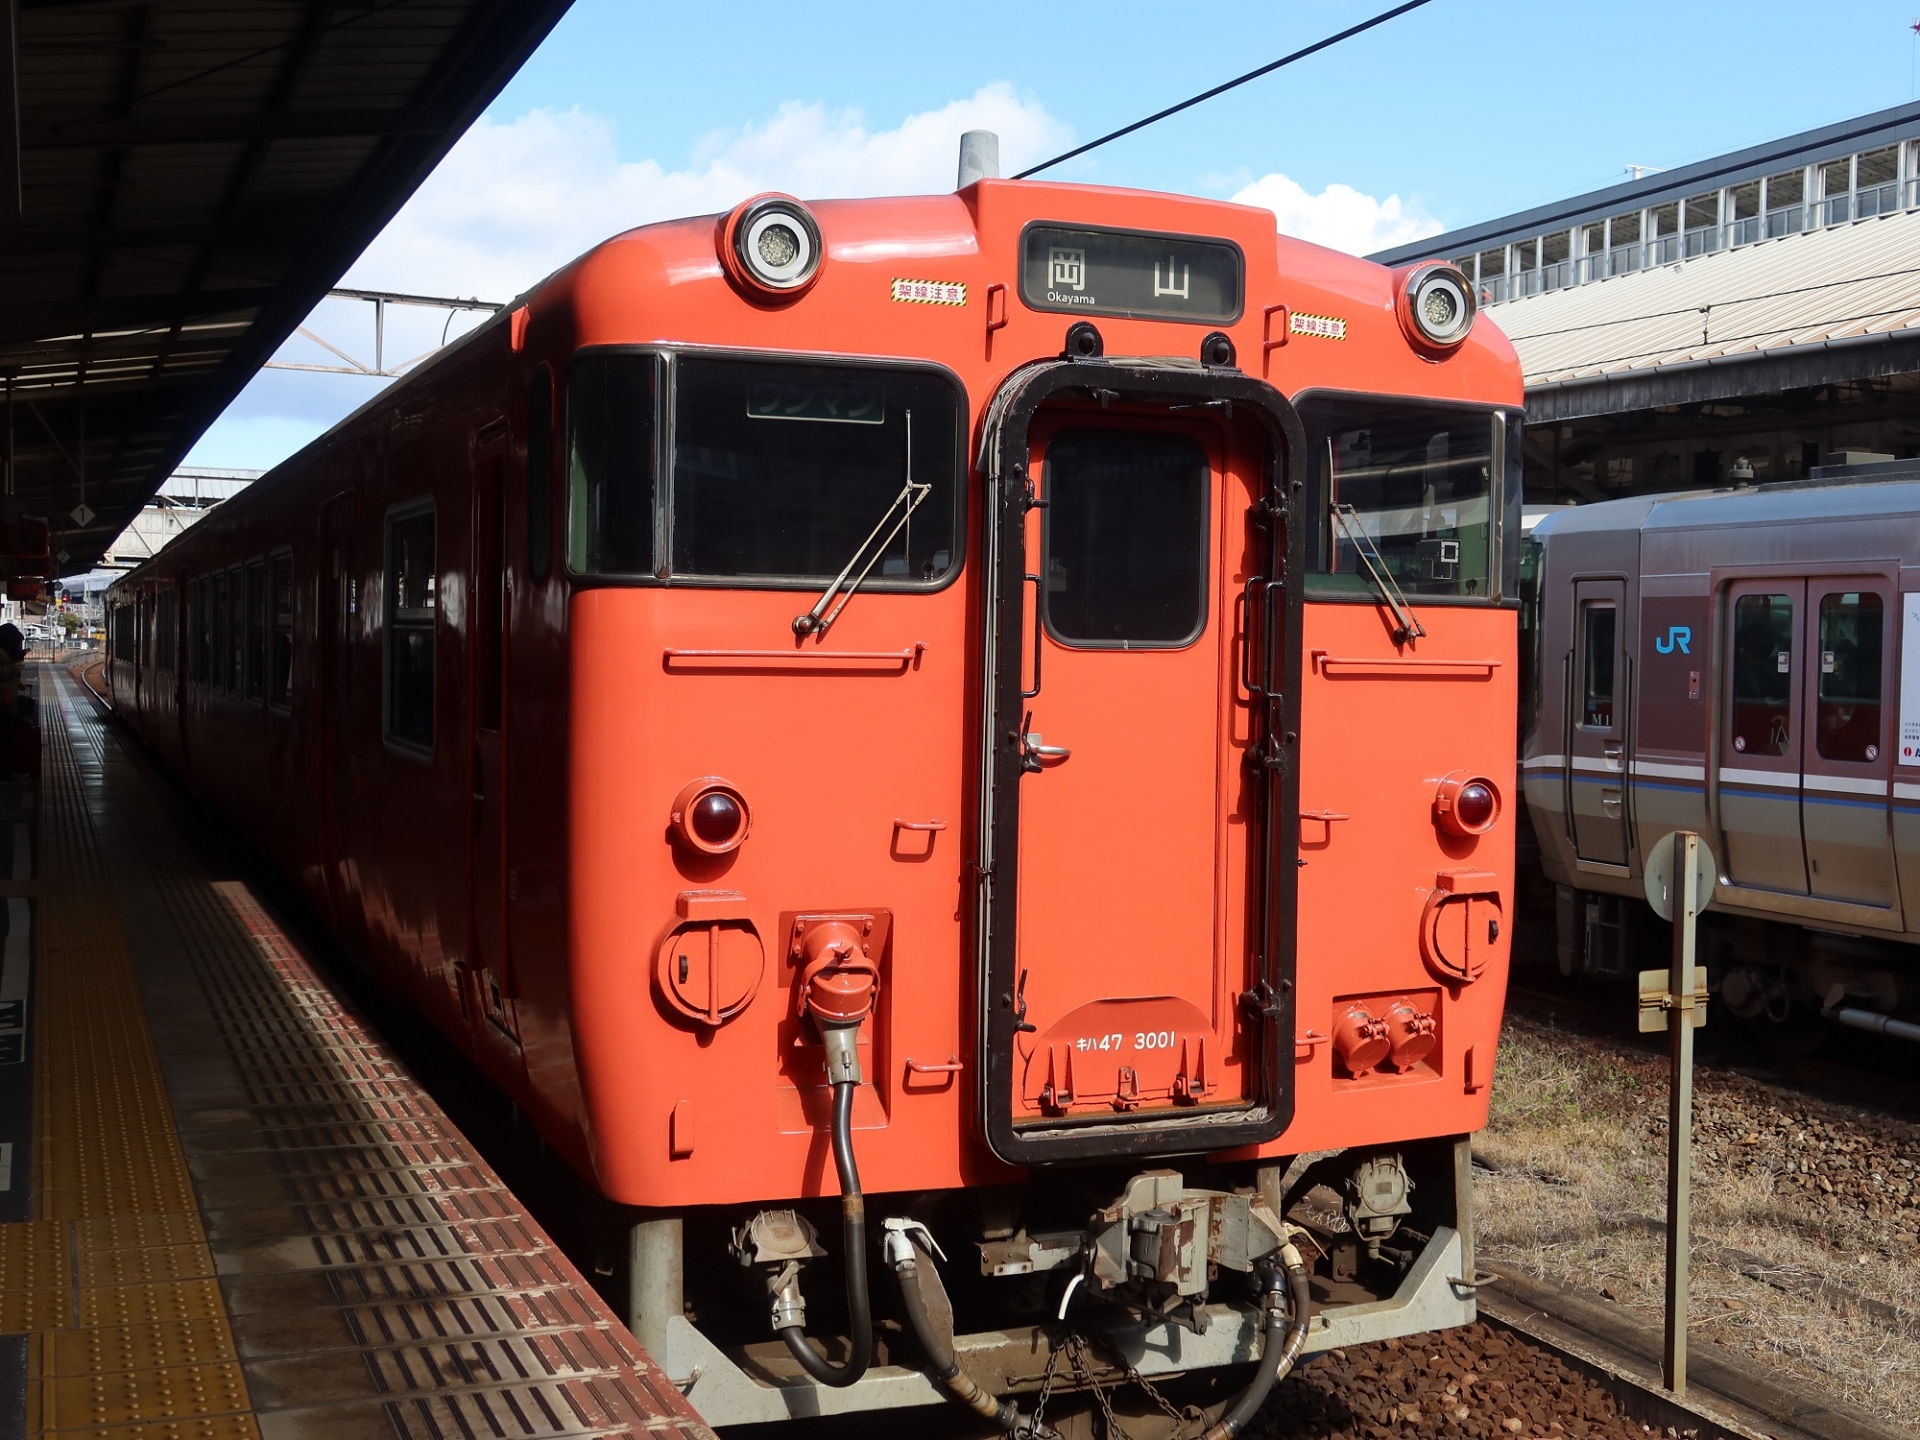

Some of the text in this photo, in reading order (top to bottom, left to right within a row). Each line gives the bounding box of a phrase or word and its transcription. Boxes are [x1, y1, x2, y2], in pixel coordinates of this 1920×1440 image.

[1048, 247, 1189, 299] 岡山
[899, 284, 959, 302] 架線注意
[1047, 291, 1095, 304] Okayama
[1294, 317, 1340, 335] 架線注意
[1656, 627, 1691, 654] JR
[1076, 1031, 1175, 1052] キハ47 3001
